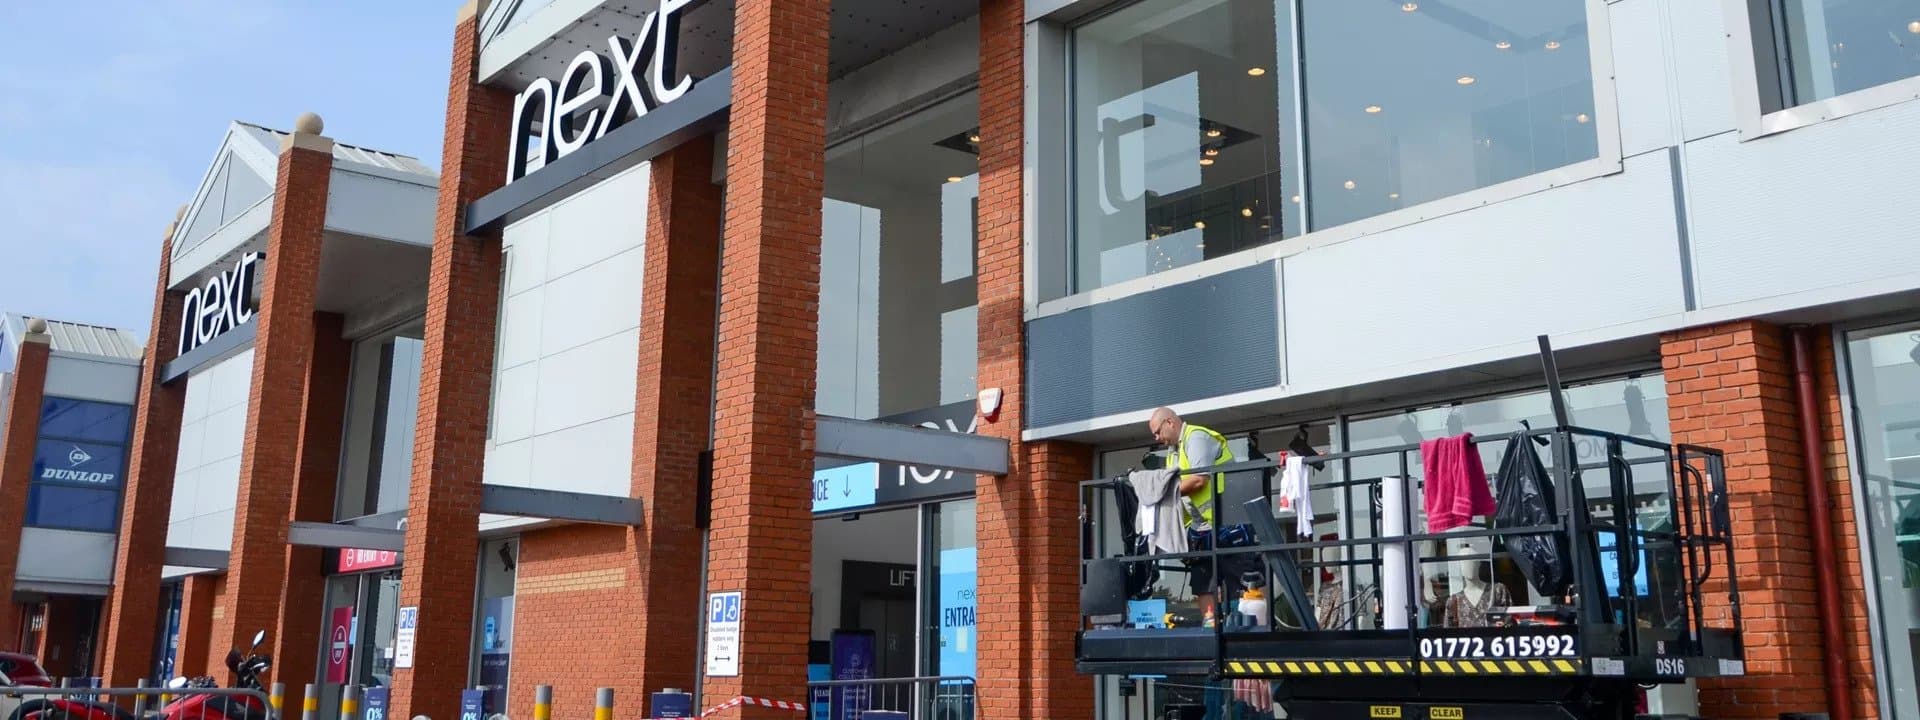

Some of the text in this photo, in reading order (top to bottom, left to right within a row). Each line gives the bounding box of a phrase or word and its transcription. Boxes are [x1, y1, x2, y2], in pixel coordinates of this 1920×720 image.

[506, 0, 692, 186] next
[178, 251, 259, 357] next
[41, 467, 115, 483] DUNLOP
[713, 599, 722, 620] P
[1420, 634, 1575, 658] 01772 615992
[1656, 659, 1685, 675] DS16
[1374, 707, 1397, 716] KEEP
[1431, 708, 1462, 717] CLEAR
